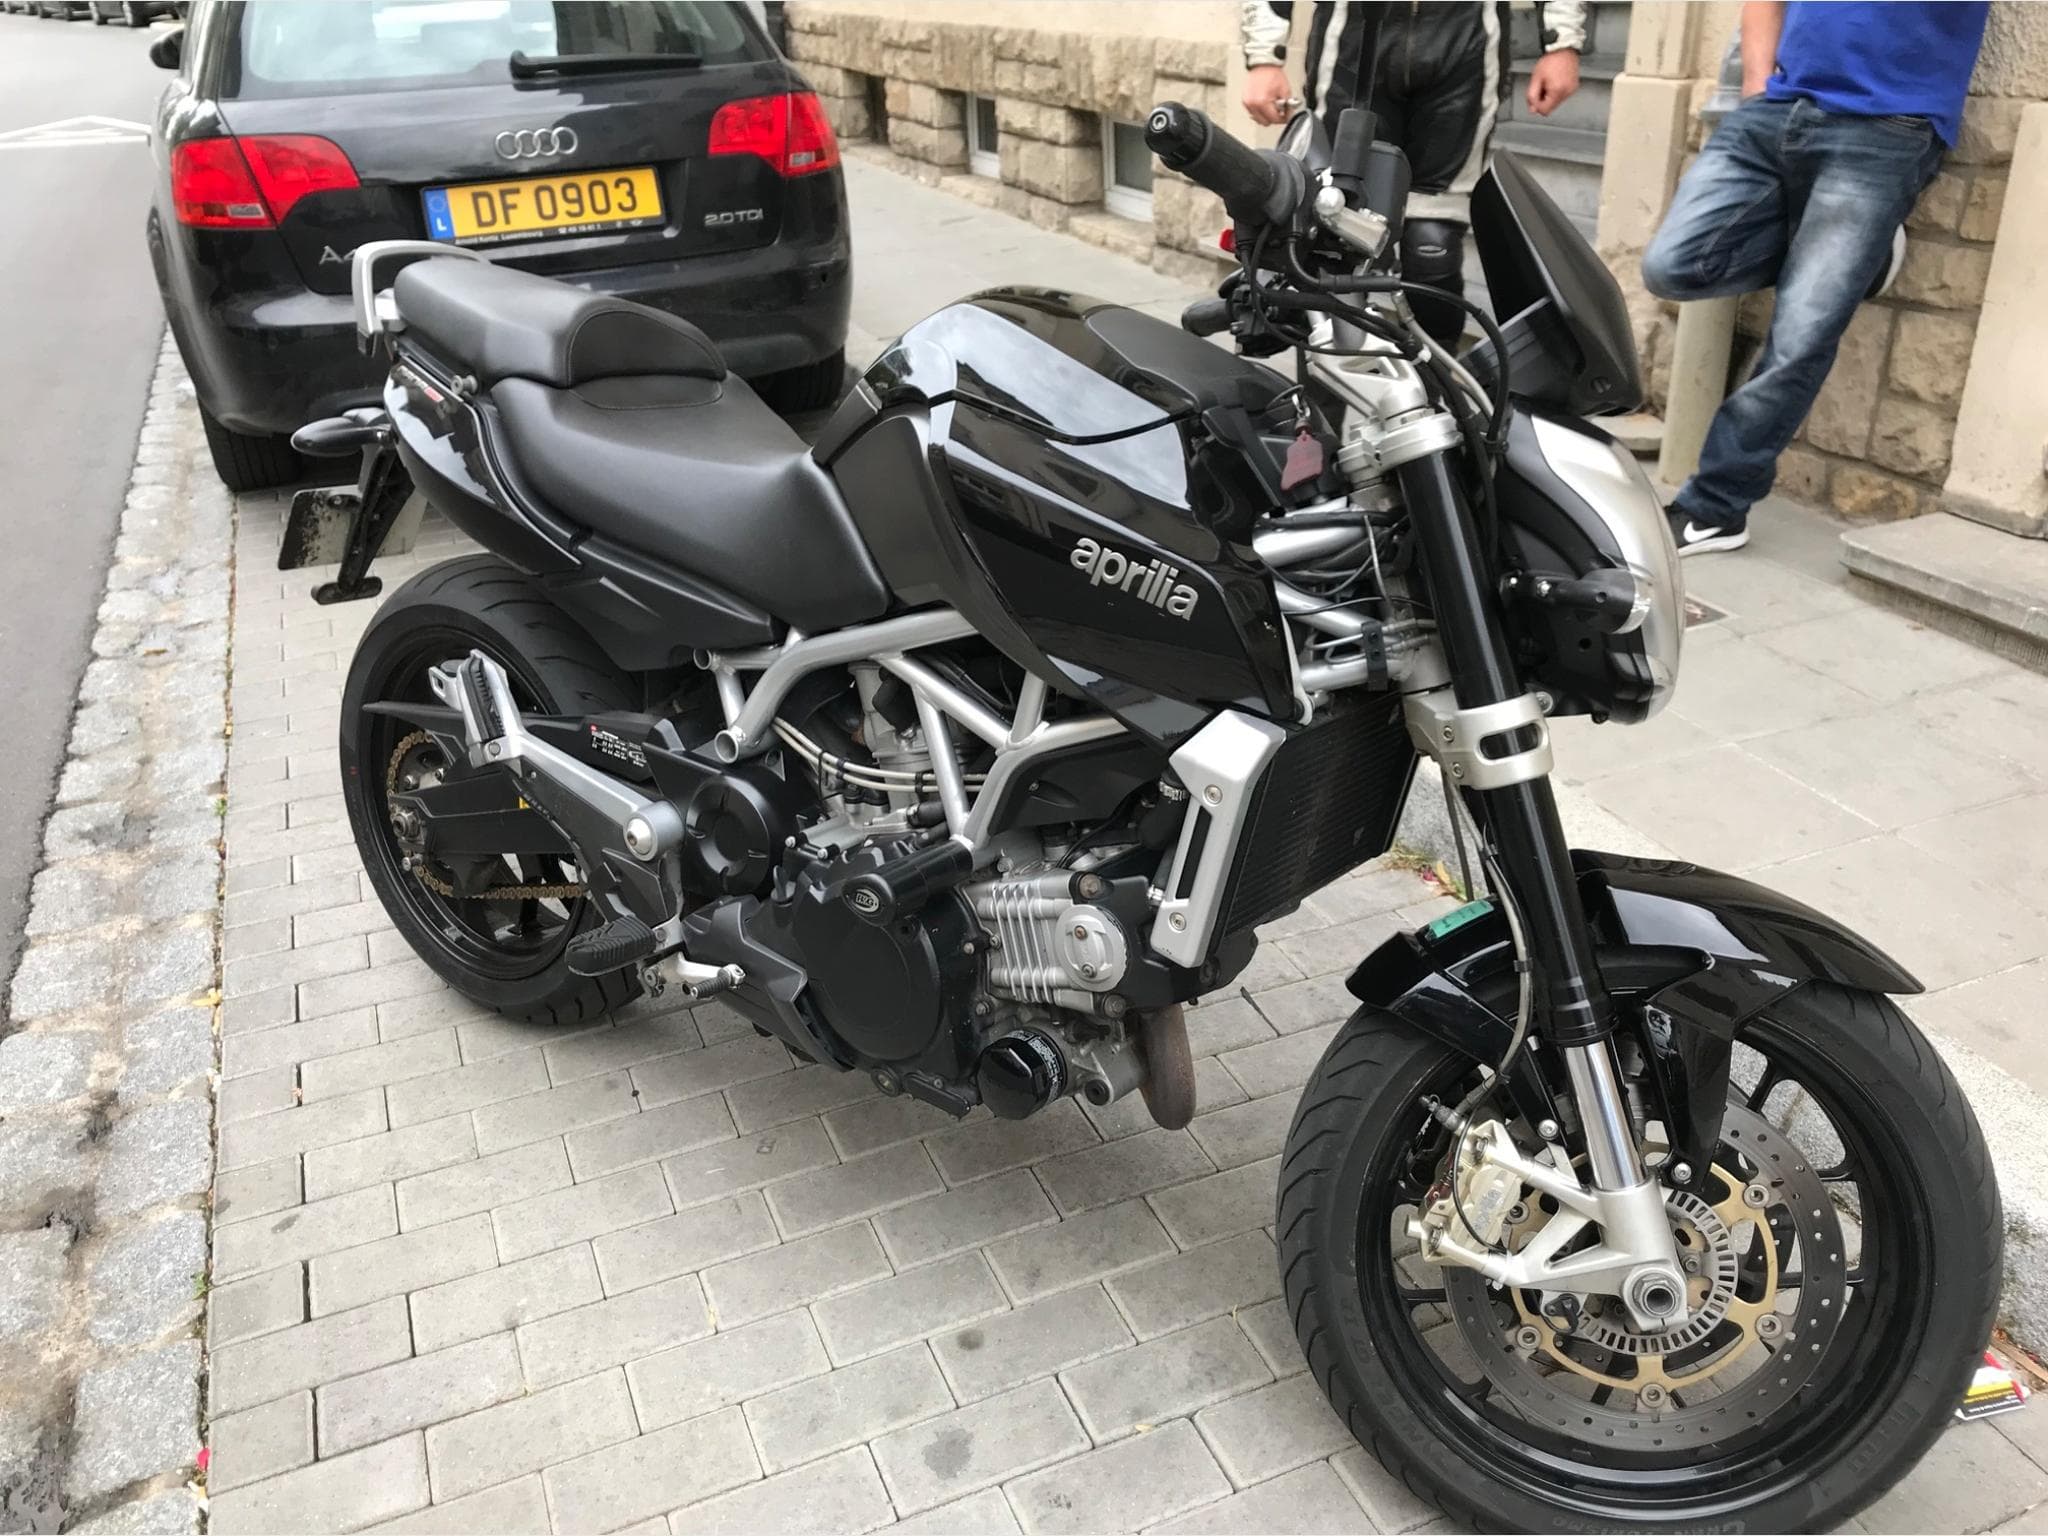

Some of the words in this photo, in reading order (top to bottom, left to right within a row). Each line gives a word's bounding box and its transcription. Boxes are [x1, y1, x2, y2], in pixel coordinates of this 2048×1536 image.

[436, 217, 447, 231] L
[471, 188, 521, 229] DF
[534, 177, 639, 221] 0903
[1070, 537, 1199, 621] aprilia
